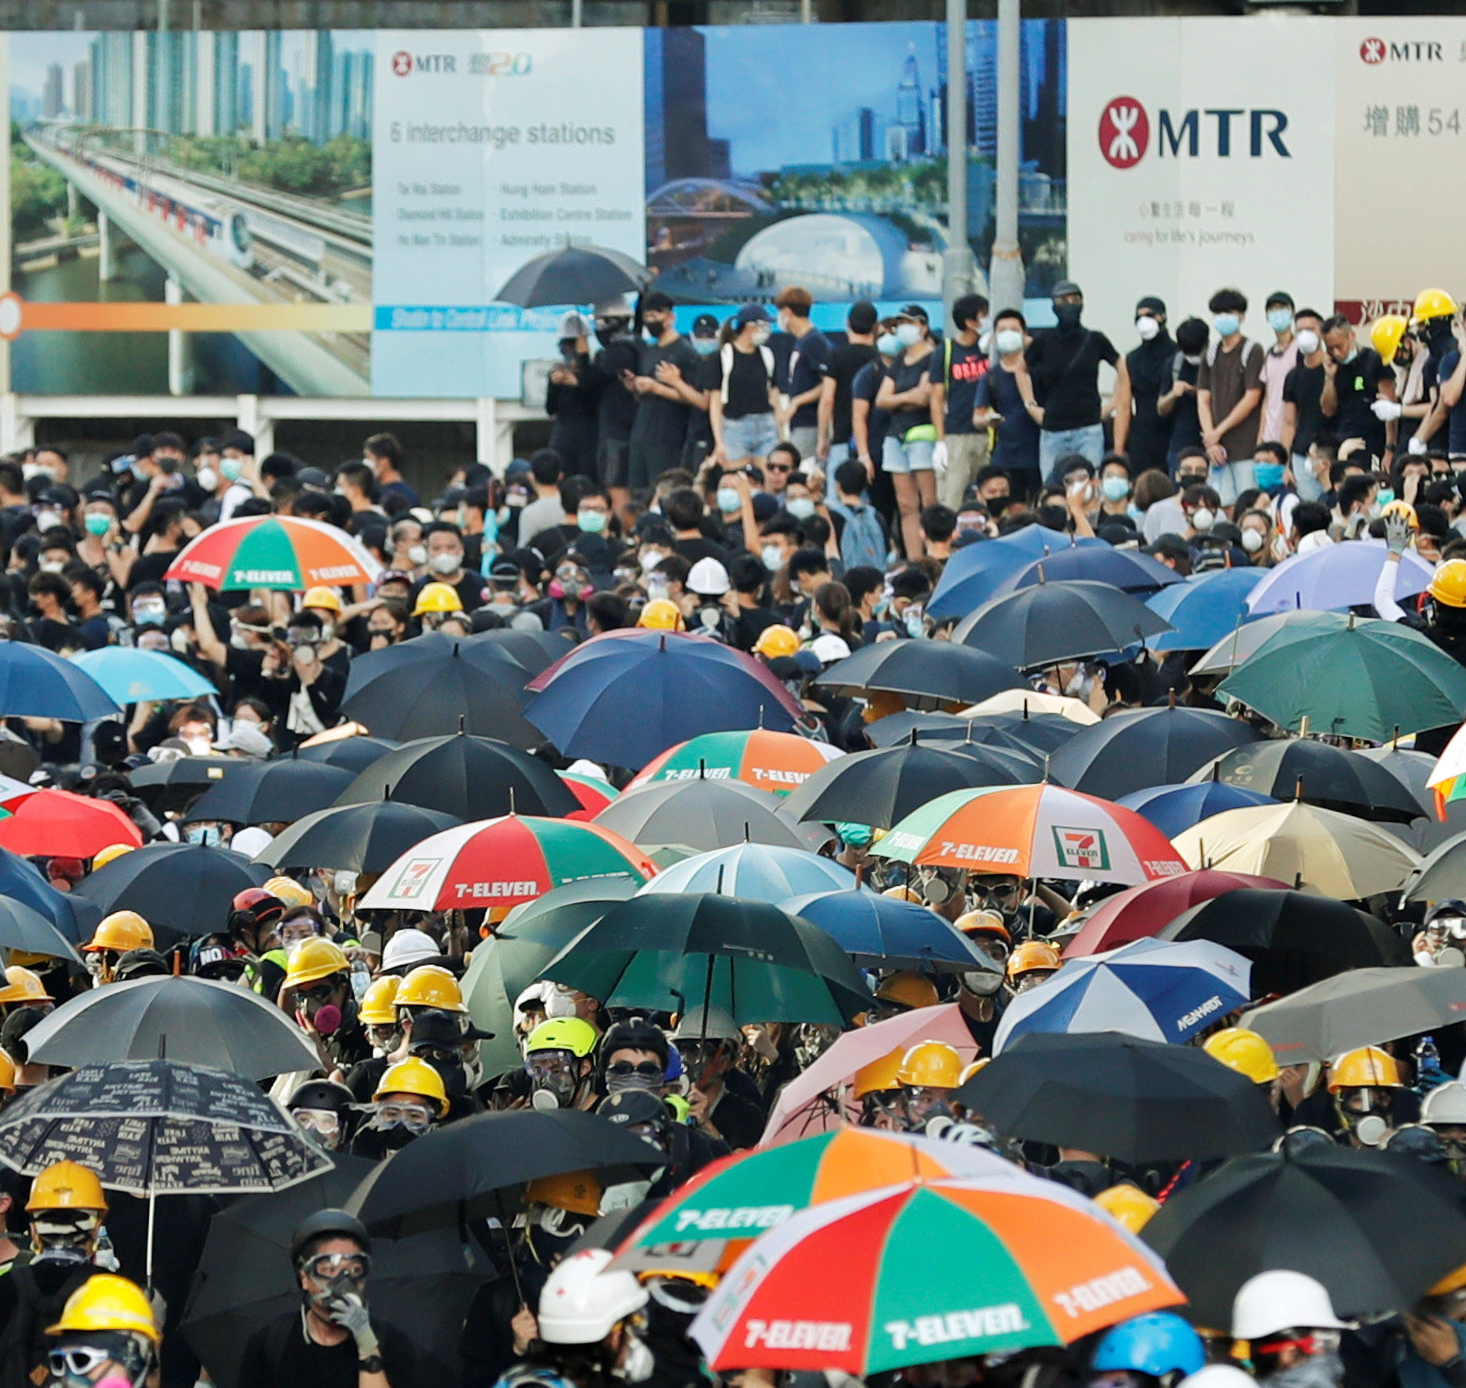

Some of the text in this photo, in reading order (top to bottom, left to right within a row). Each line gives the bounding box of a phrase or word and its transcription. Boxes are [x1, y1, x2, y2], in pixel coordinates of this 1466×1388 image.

[1391, 41, 1443, 62] MTR
[415, 54, 457, 73] MTR
[391, 120, 616, 149] 6 interchange stations
[1159, 109, 1292, 158] MTR
[560, 182, 596, 195] Station
[1198, 229, 1255, 248] journeys
[234, 569, 295, 584] 7-ELEVEN
[665, 767, 732, 781] 7-ELVEN
[751, 767, 811, 784] 7-ELEV
[940, 841, 1020, 864] 7-ELEVEN
[455, 881, 538, 898] 7-ELEVEN
[674, 1204, 794, 1232] 7-ELEVEN
[1053, 1265, 1151, 1318] 7-ELEVEN
[744, 1319, 853, 1352] 7-ELEVEN
[884, 1302, 1028, 1350] 7-ELEVEN
